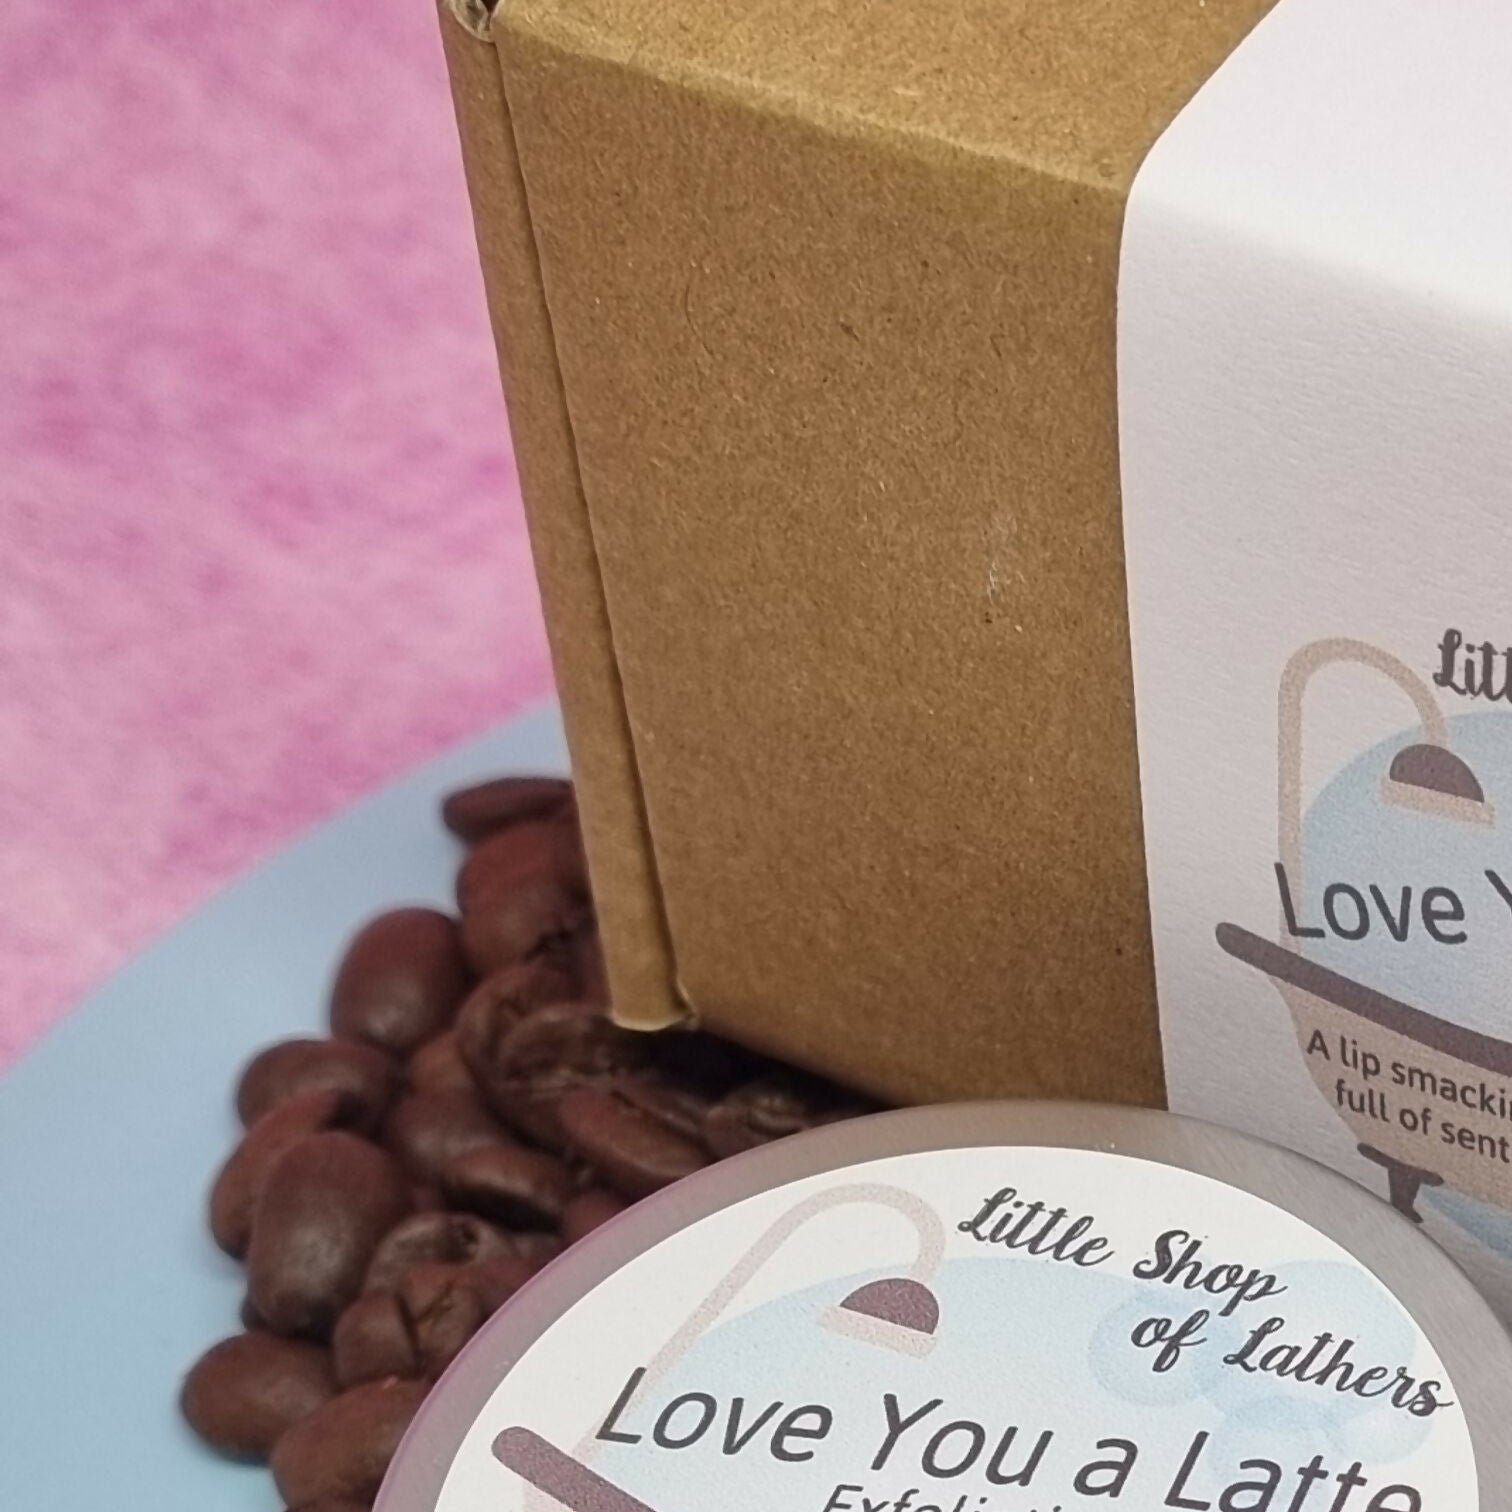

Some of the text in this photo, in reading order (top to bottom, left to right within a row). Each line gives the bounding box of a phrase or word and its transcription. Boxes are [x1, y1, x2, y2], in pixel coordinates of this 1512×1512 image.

[1274, 863, 1467, 944] Love
[1307, 1029, 1330, 1060] A
[1340, 1036, 1380, 1080] lip
[1336, 1079, 1389, 1122] full
[1400, 1107, 1431, 1135] of
[958, 1188, 1288, 1314] Little Shop
[1131, 1310, 1454, 1416] of Lathers
[595, 1367, 832, 1462] Love
[871, 1394, 1053, 1486] You
[1073, 1439, 1138, 1497] a
